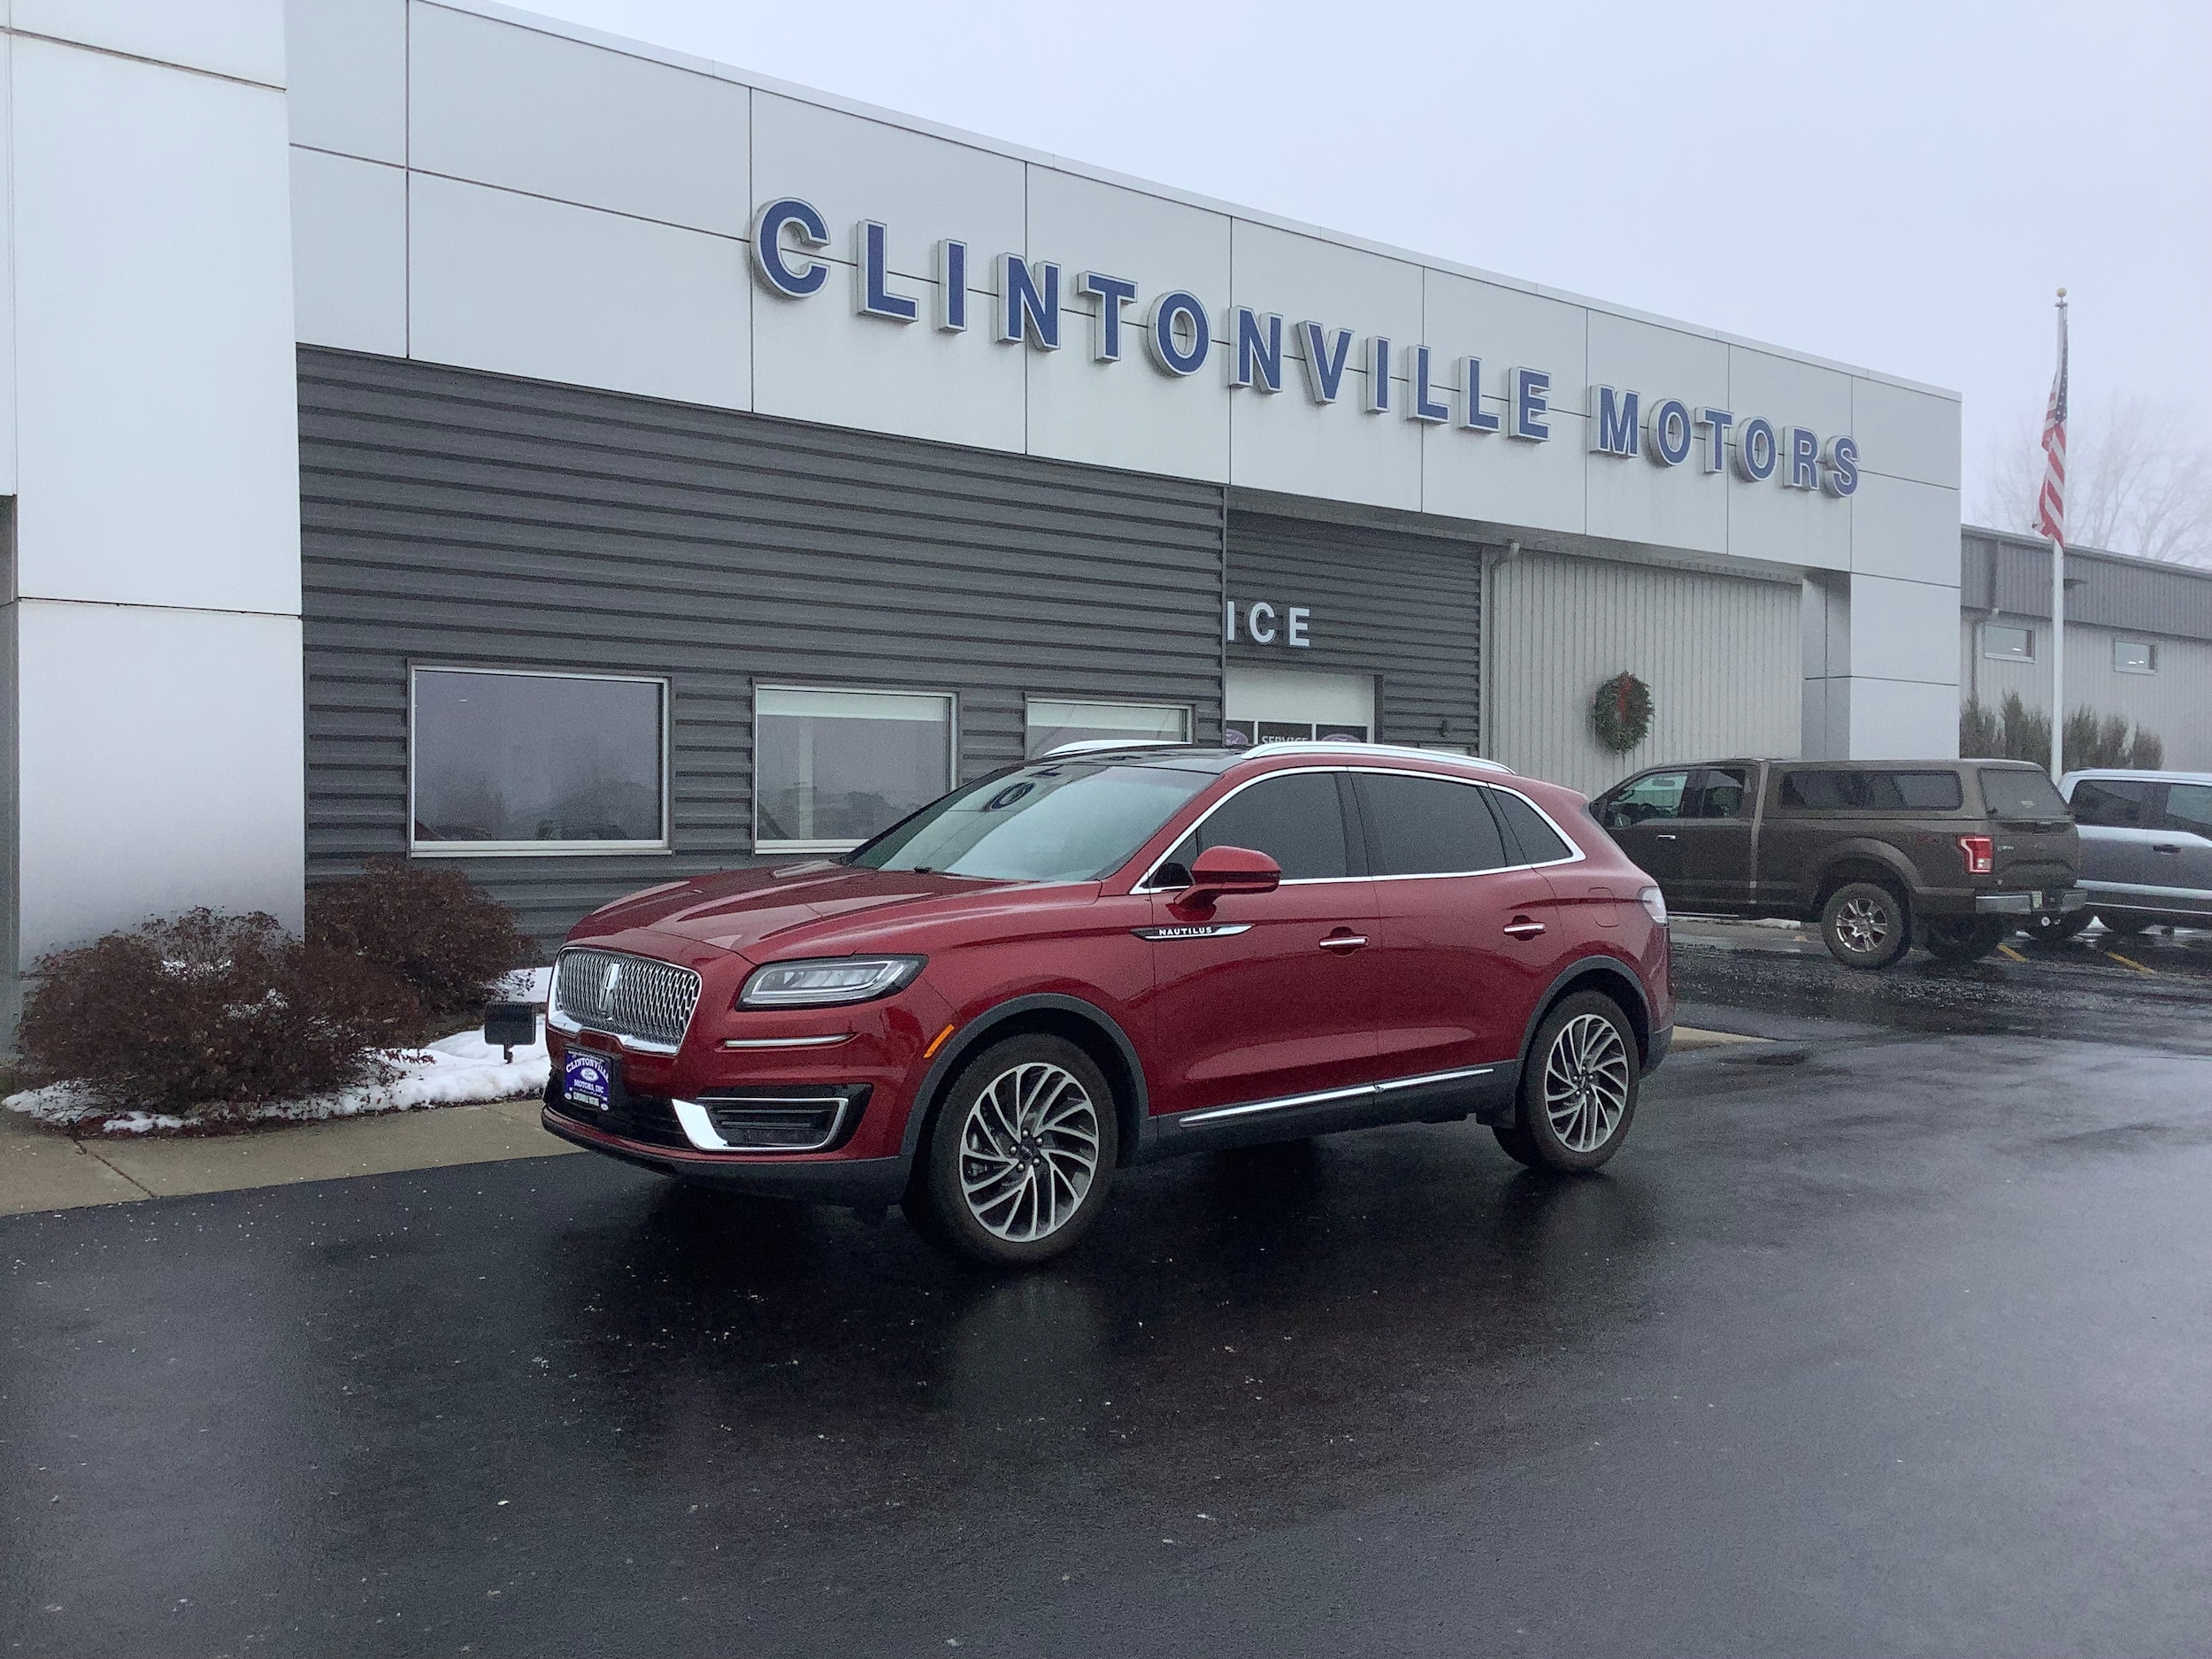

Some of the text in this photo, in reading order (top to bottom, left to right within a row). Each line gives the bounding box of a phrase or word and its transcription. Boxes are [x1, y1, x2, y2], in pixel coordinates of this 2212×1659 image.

[753, 197, 1860, 497] CLINTONVILLE MOTORS
[1227, 601, 1310, 648] ICE
[1158, 926, 1212, 936] NAUTILUS
